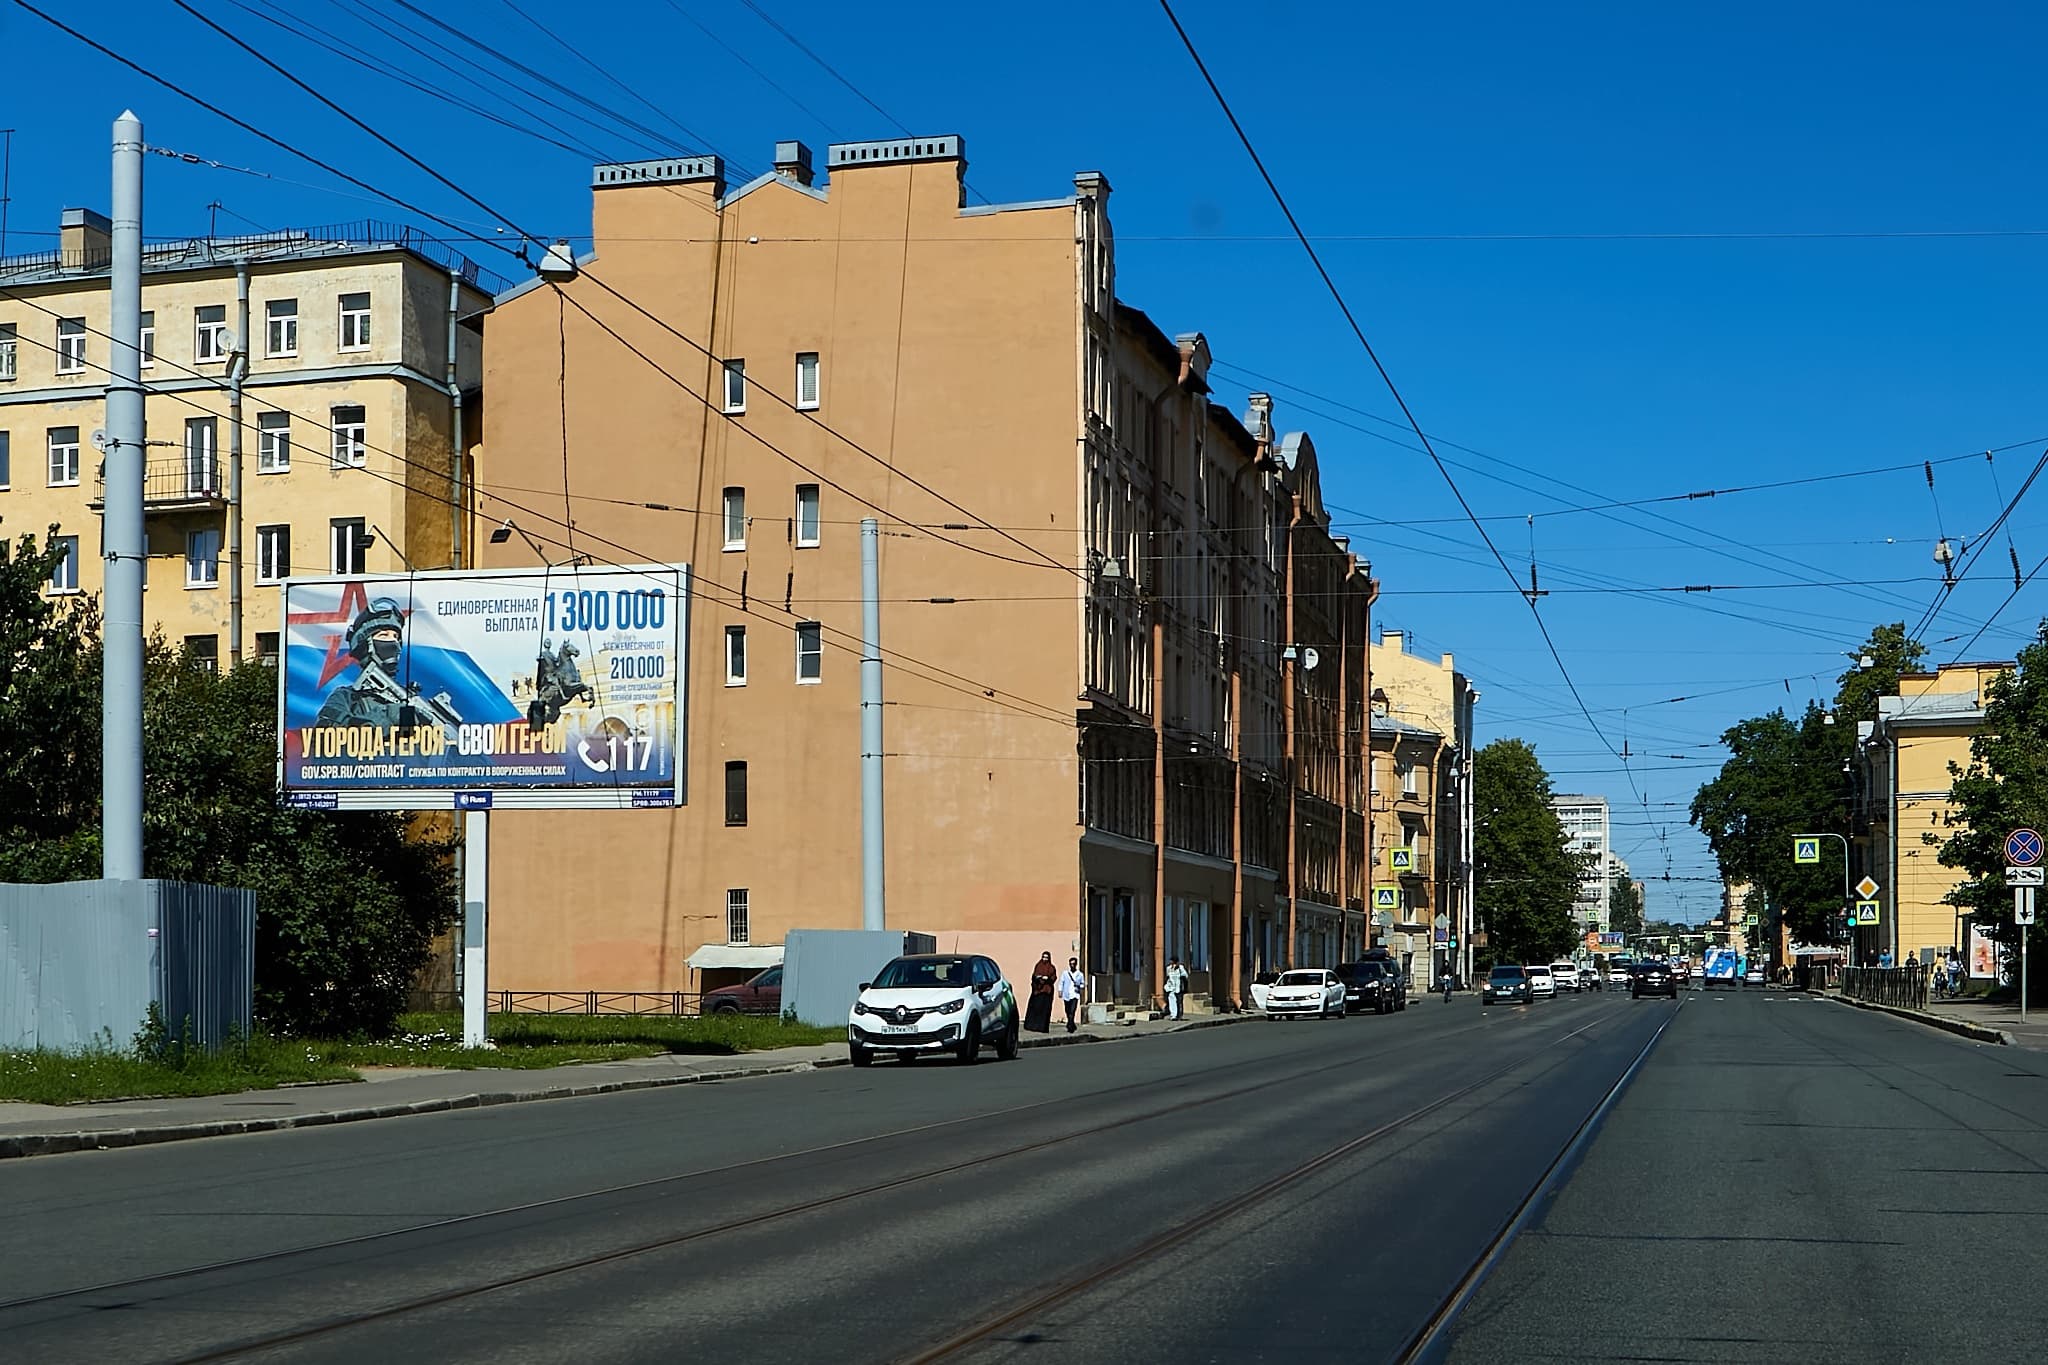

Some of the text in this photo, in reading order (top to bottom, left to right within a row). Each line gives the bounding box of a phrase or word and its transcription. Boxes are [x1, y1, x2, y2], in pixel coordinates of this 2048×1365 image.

[437, 598, 539, 617] ЕДИНОВРЕМЕННАЯ
[546, 588, 665, 632] 1 300 000
[485, 616, 539, 633] ВЫПЛАТА
[656, 640, 665, 650] ОТ
[610, 655, 665, 680] 210 000
[301, 727, 313, 758] У
[314, 724, 445, 761] ГОРОДА-ГЕРОЯ
[458, 723, 507, 756] СВОИ
[606, 736, 653, 771] 117
[301, 764, 406, 779] GOV.SPB.RU/CONTRACT
[408, 765, 566, 778] СЛУЖБА ПО КОНТРАКТУ В ВООРУЖЕННЫХ СИЛАХ
